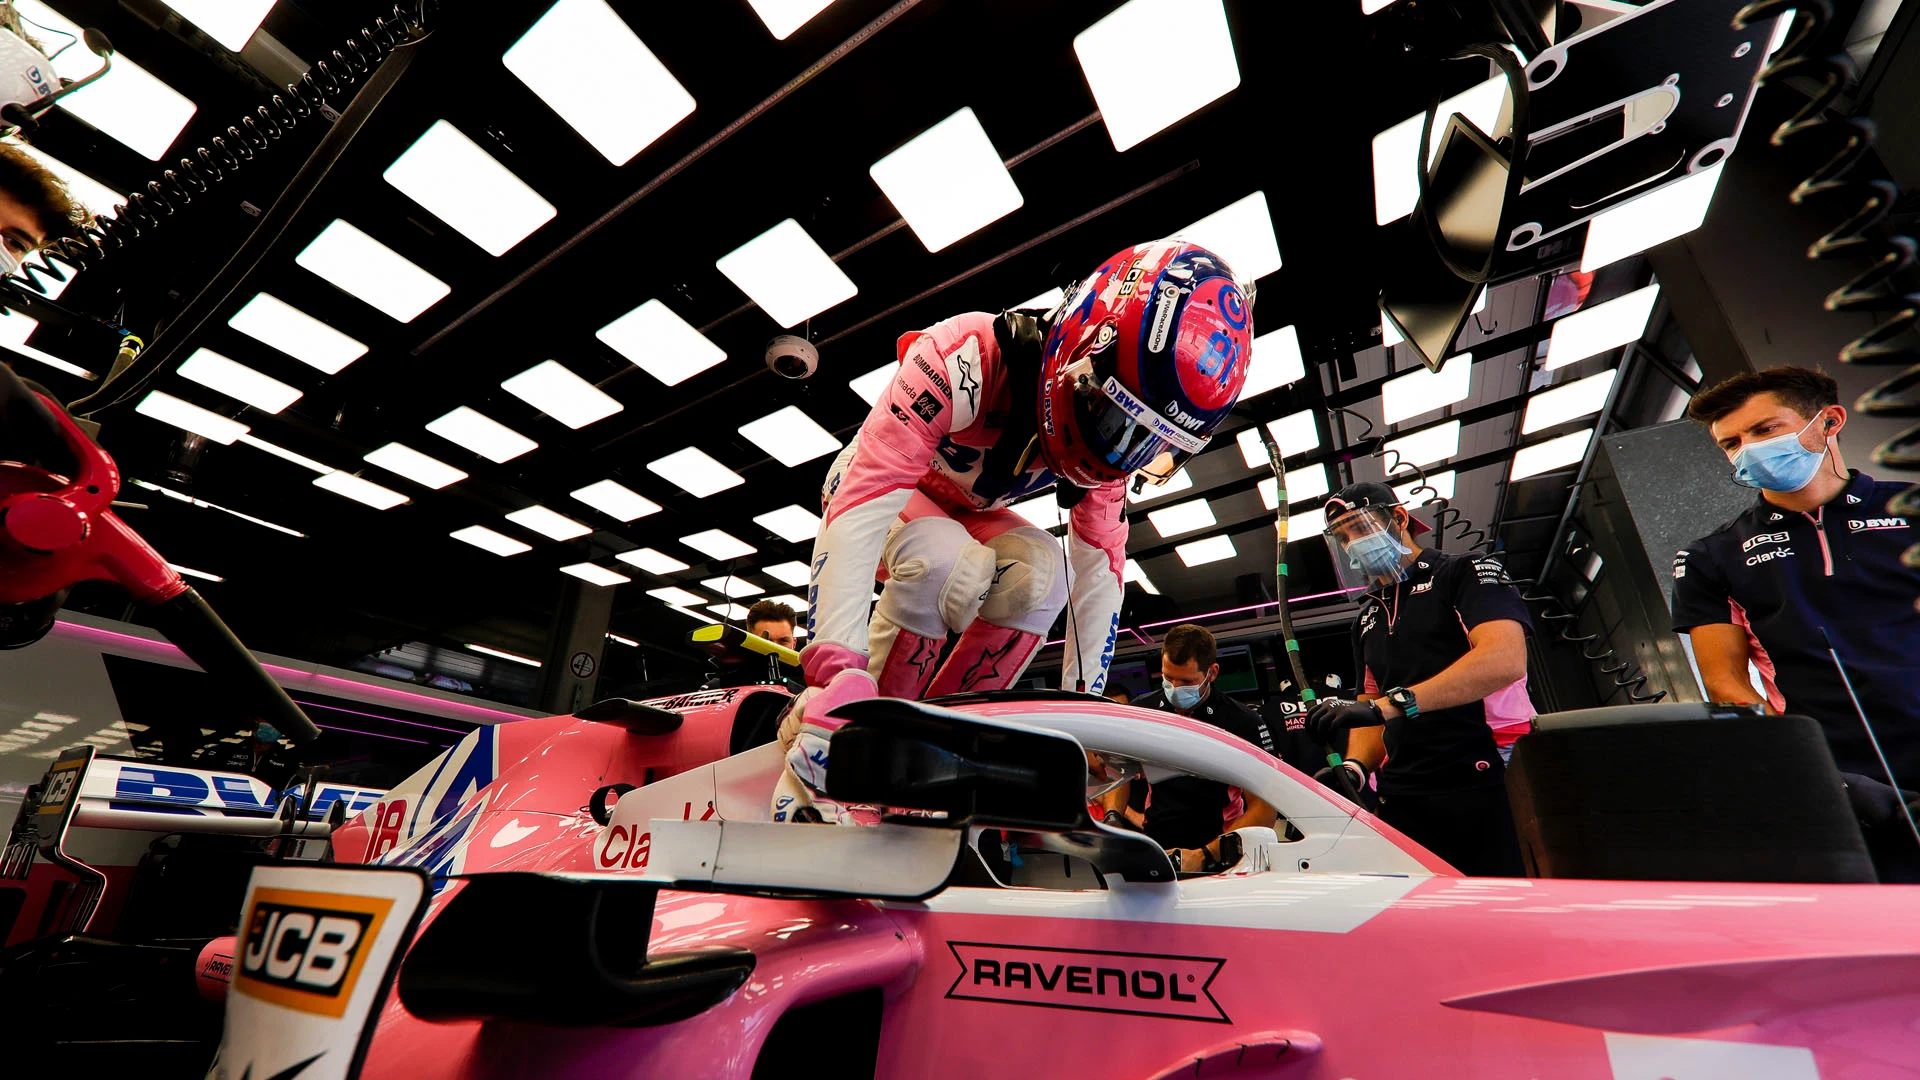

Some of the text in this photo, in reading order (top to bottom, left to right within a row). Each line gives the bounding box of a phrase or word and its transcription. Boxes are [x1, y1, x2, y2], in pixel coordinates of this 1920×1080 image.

[1153, 300, 1171, 351] #WeRaceAsOne
[897, 376, 917, 399] anada
[917, 396, 936, 418] life
[1114, 391, 1145, 417] BWT
[1158, 423, 1176, 436] BWT
[1174, 411, 1206, 431] BWT
[1745, 547, 1794, 567] Claro
[1101, 612, 1119, 670] BWT
[363, 799, 408, 865] 18
[600, 824, 651, 869] Cla
[244, 910, 363, 988] JCB
